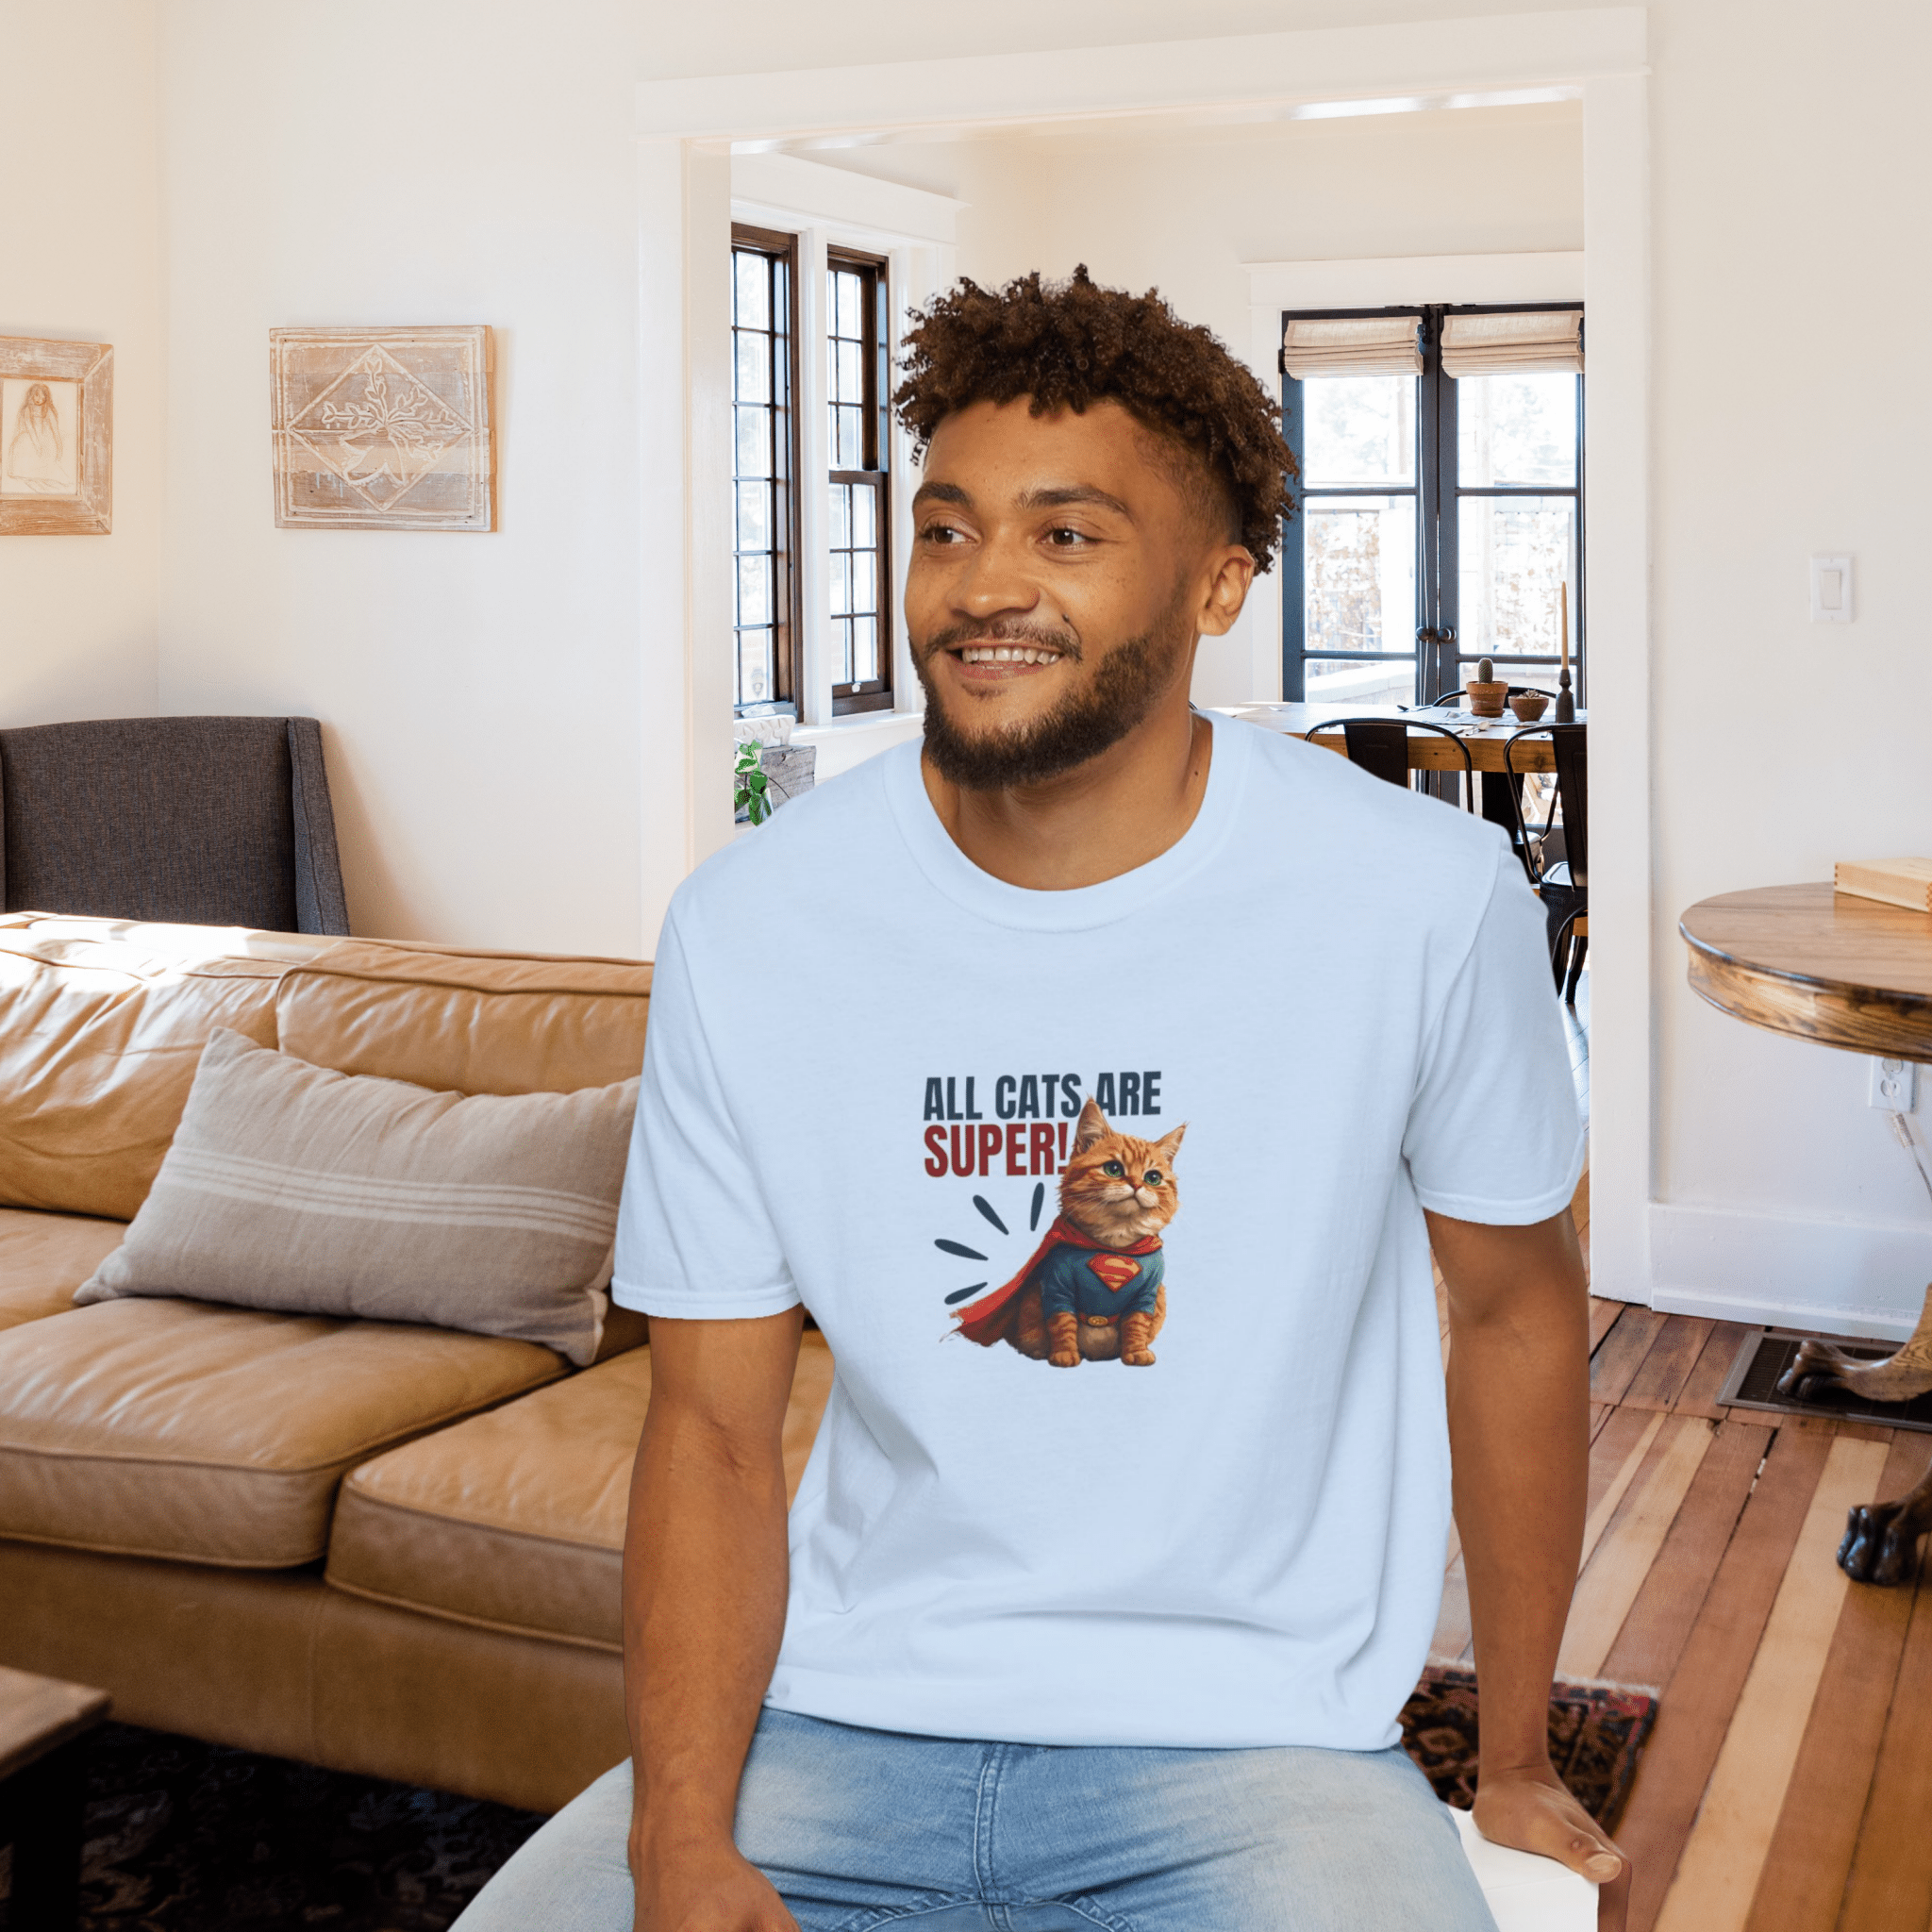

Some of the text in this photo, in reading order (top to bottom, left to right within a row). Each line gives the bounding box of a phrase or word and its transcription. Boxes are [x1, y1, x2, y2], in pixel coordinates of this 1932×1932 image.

[924, 1071, 1161, 1121] ALL CATS ARE
[924, 1122, 1070, 1177] SUPER!
